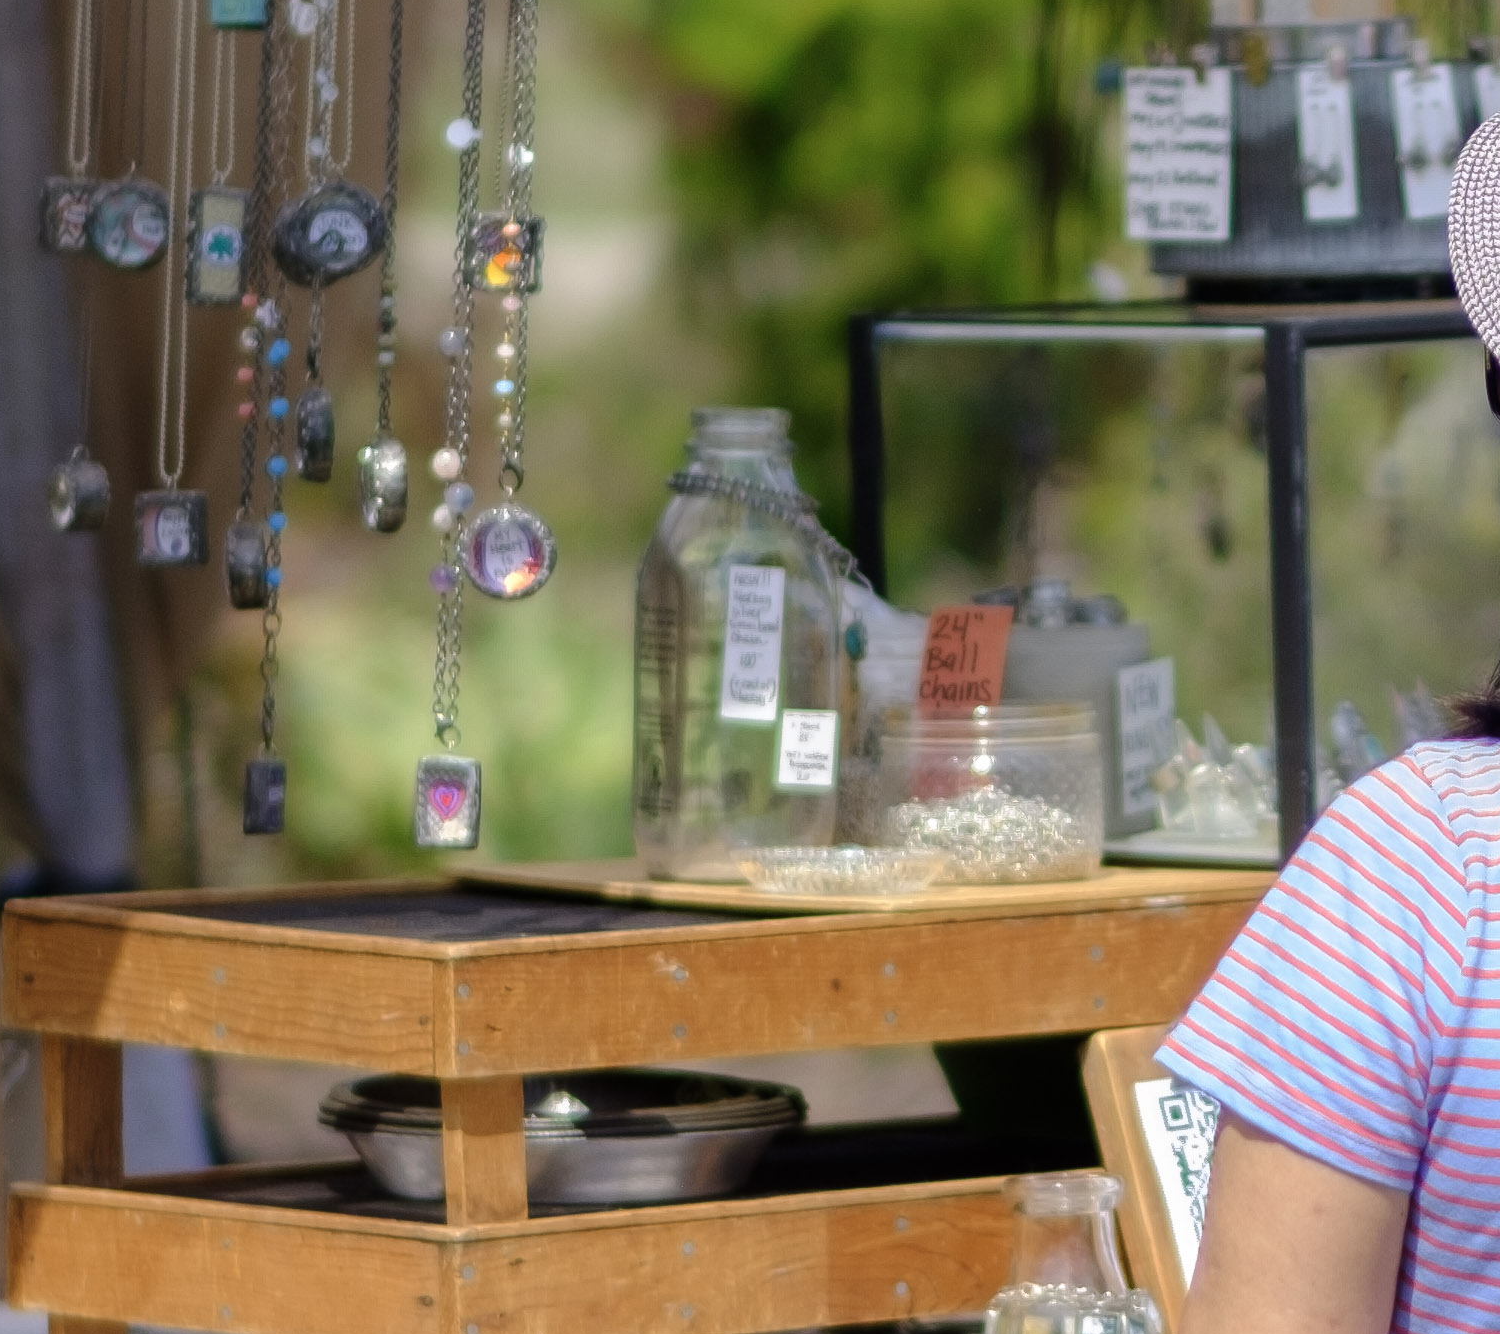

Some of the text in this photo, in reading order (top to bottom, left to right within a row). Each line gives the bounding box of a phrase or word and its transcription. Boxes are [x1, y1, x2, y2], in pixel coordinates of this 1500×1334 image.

[931, 610, 985, 641] 24"
[926, 643, 978, 673] Ball
[919, 676, 992, 704] chains
